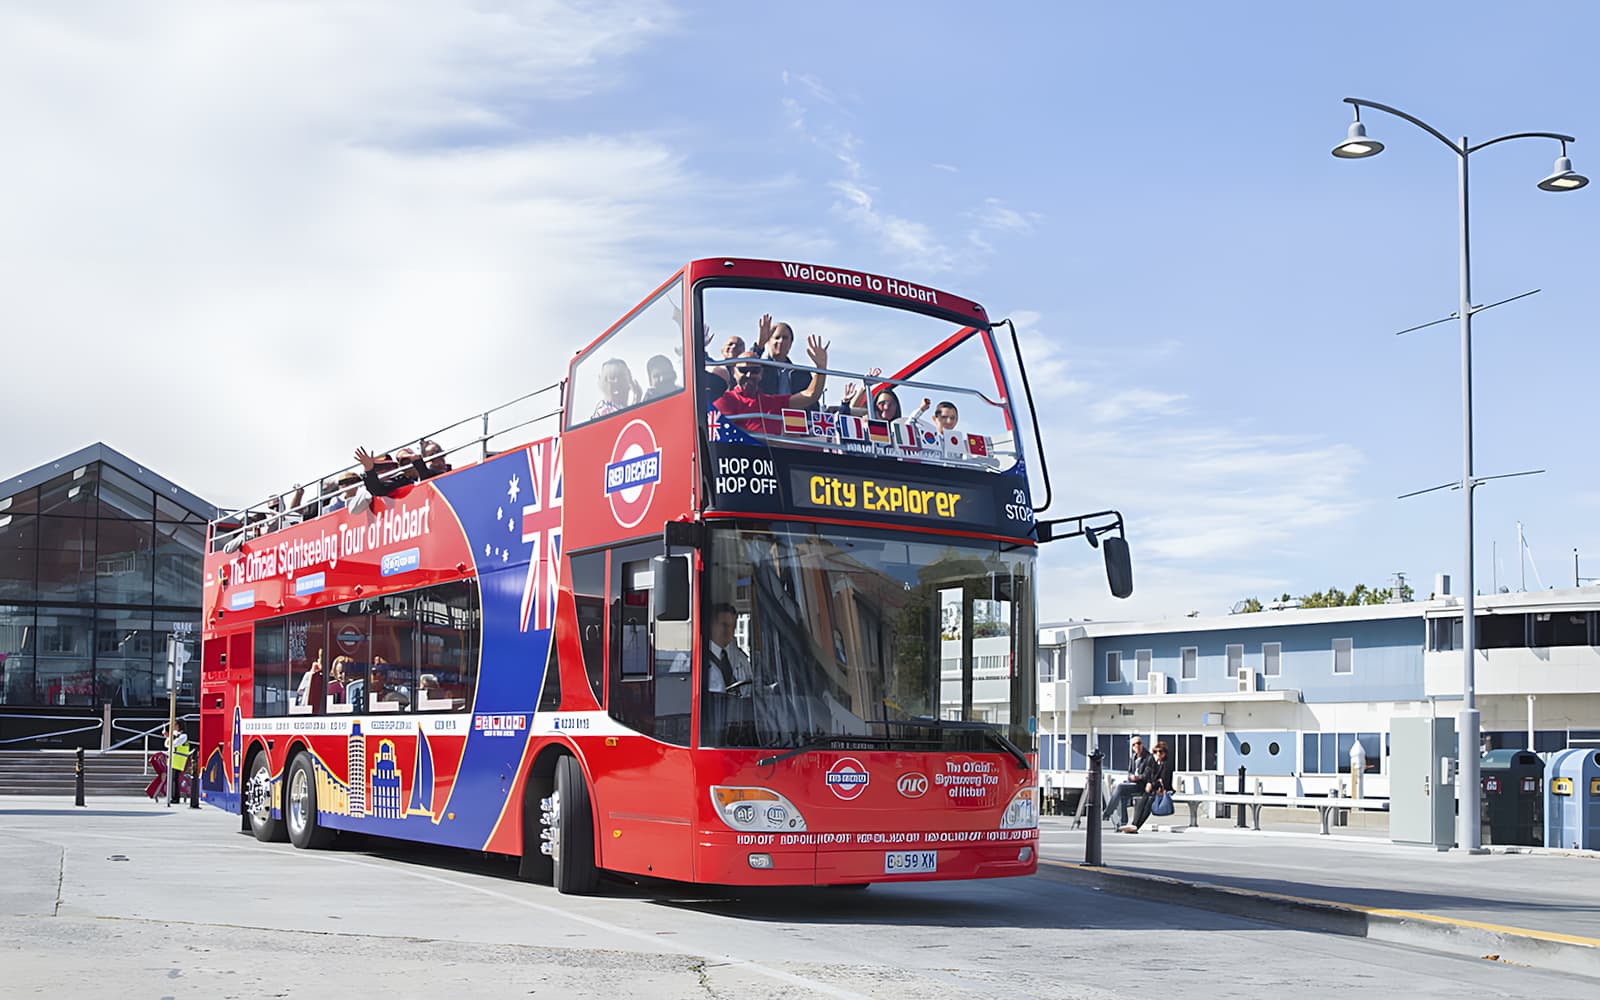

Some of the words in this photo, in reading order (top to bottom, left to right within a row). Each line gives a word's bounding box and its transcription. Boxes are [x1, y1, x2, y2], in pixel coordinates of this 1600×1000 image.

[781, 262, 862, 288] Welcome
[866, 274, 883, 291] to
[887, 279, 938, 304] Hobart
[716, 476, 747, 494] HOP
[750, 478, 777, 495] OFF
[719, 457, 750, 475] HOP
[753, 459, 774, 476] ON
[810, 475, 857, 508] City
[862, 480, 961, 518] Explorer
[229, 559, 245, 587] The
[245, 546, 278, 583] Official
[278, 529, 338, 580] Sightseeing
[339, 523, 367, 557] Tour
[368, 511, 383, 550] of
[383, 498, 430, 546] Hobart
